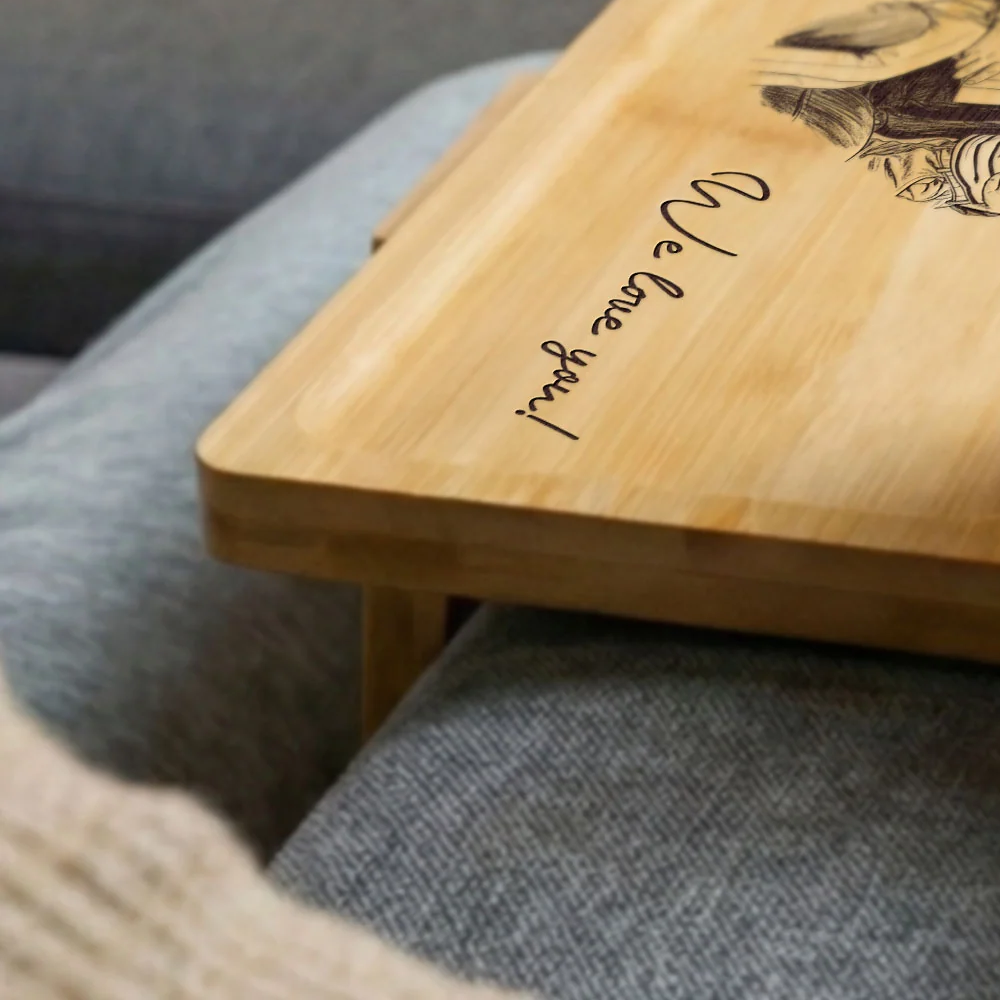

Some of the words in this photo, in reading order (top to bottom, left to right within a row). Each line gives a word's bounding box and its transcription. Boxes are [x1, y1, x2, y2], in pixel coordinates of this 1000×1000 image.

[653, 171, 770, 258] We
[591, 271, 684, 335] love
[515, 340, 596, 440] you!
